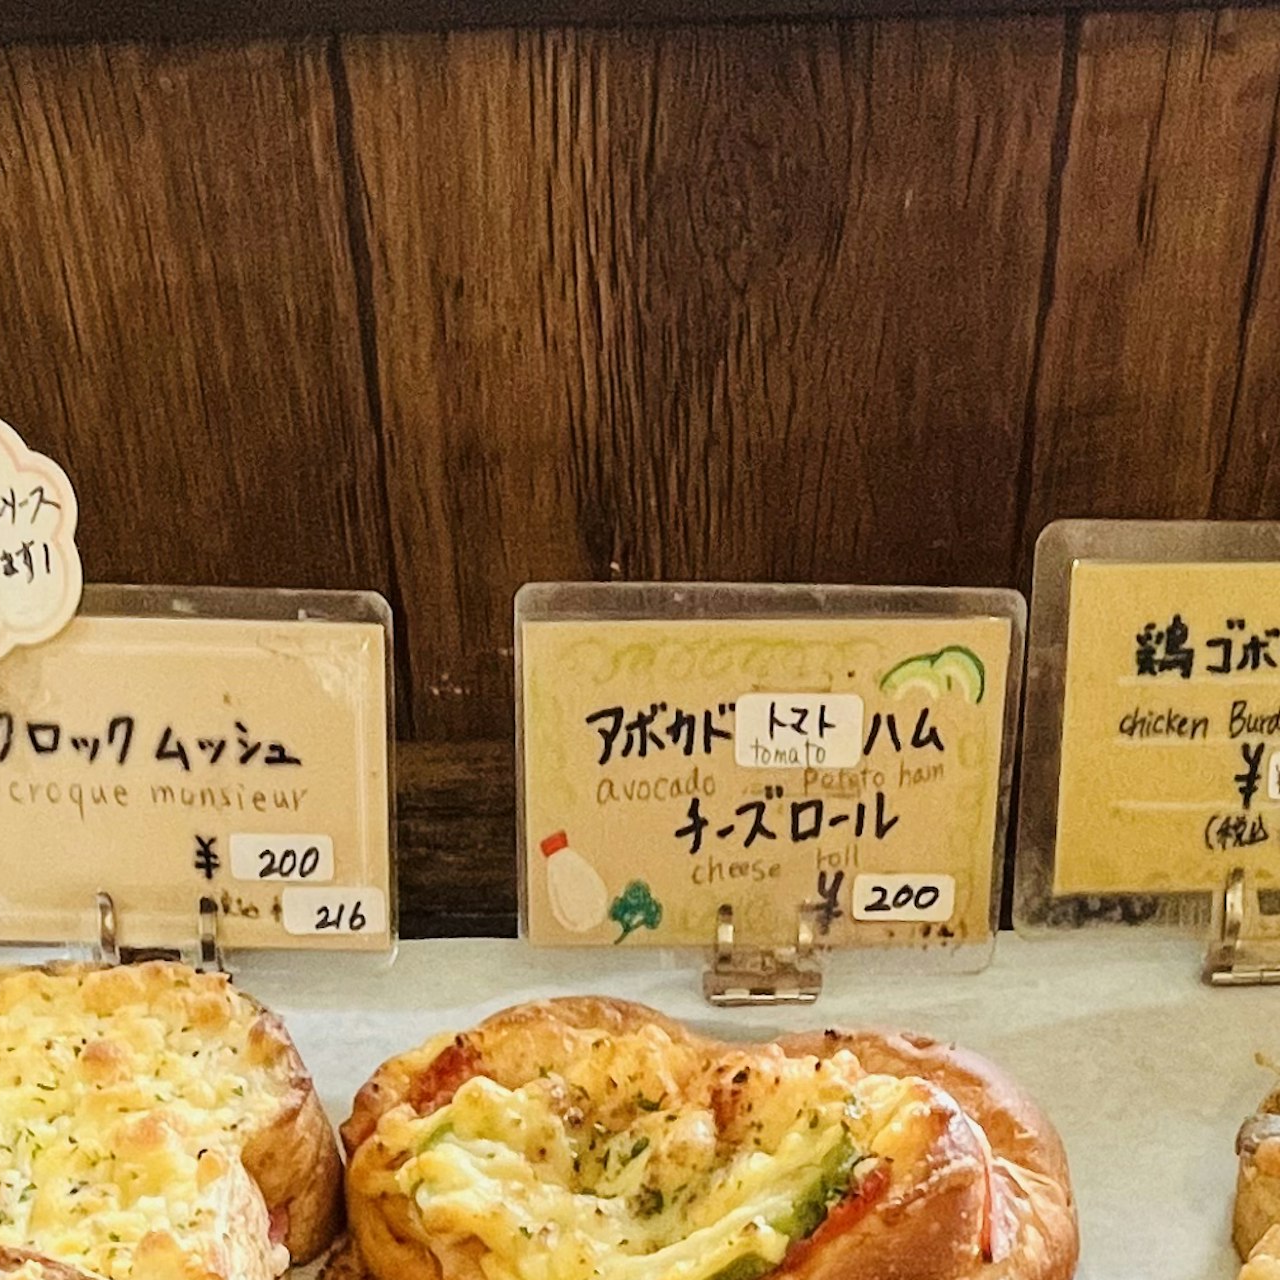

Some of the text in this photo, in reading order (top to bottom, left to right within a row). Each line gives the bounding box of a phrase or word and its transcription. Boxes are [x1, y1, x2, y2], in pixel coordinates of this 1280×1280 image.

[585, 701, 945, 766] アボカド トマト ハム
[749, 738, 827, 768] tomato
[596, 766, 717, 804] avocado
[674, 790, 900, 855] チーズロール
[690, 852, 783, 887] cheese
